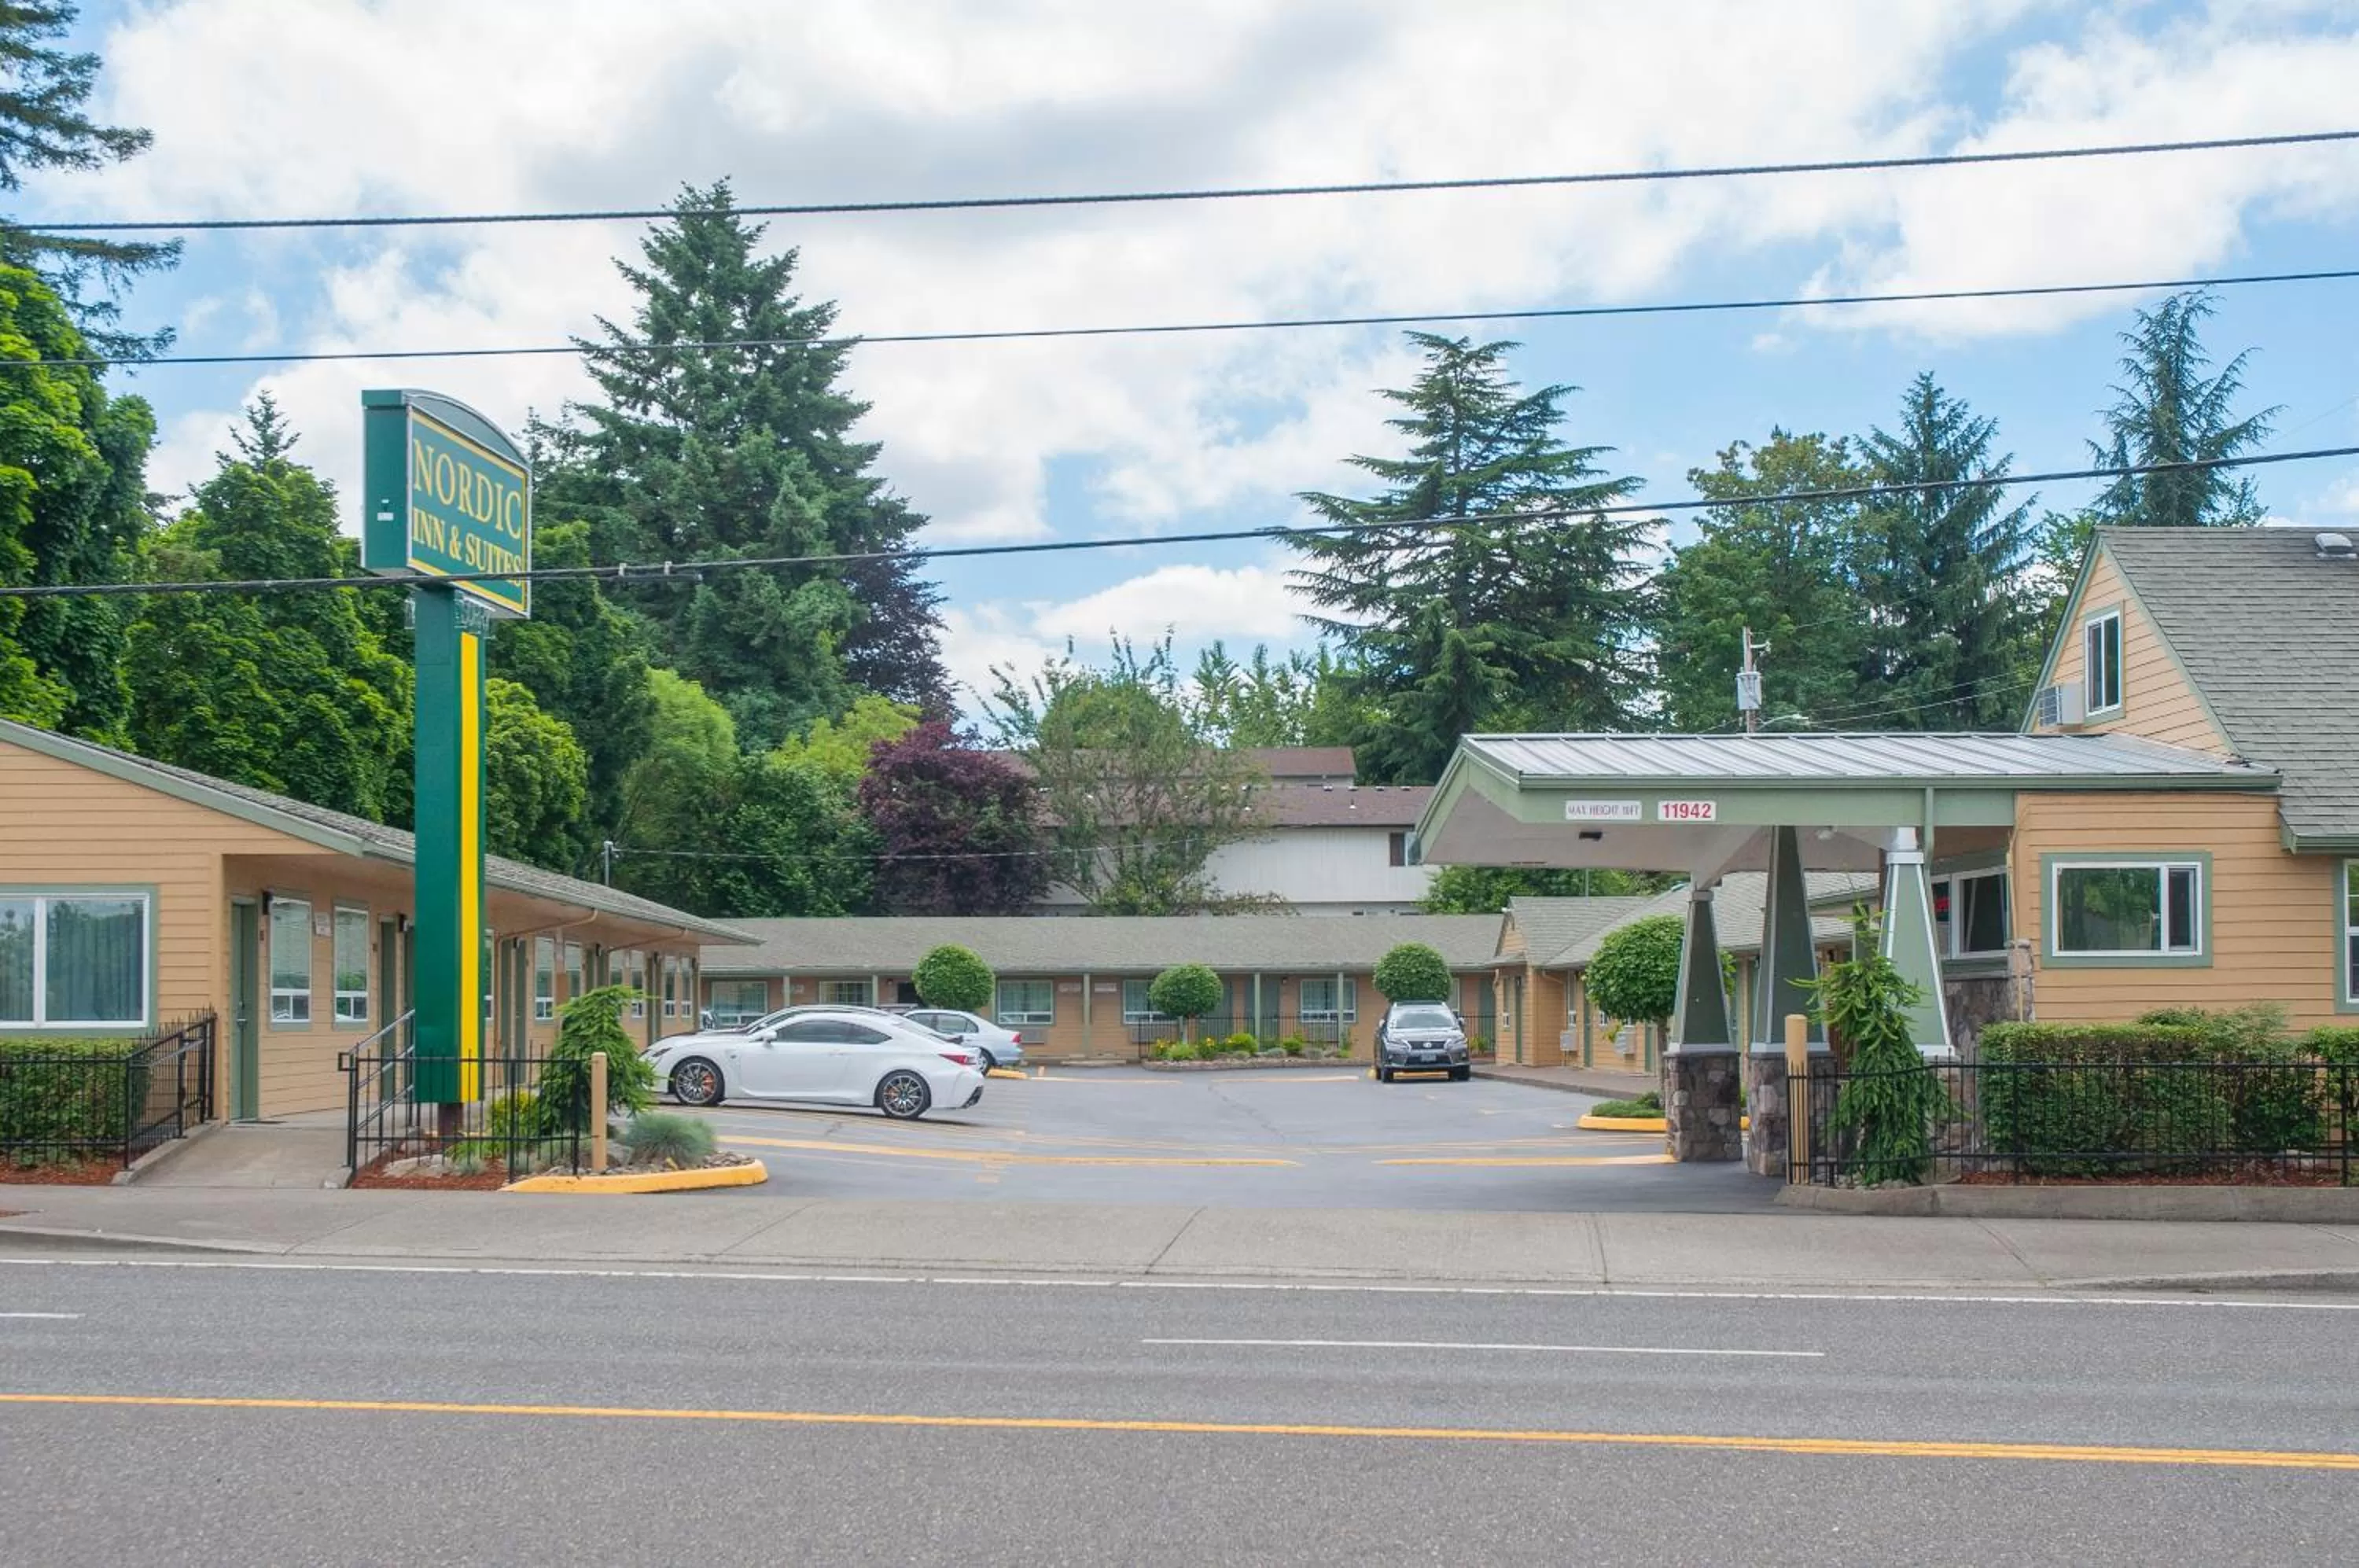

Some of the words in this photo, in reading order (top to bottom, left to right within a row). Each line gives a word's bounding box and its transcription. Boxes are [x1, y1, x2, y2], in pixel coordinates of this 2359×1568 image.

[414, 439, 521, 539] NORDIC
[413, 507, 446, 554] INN
[449, 525, 461, 561] &
[465, 532, 522, 587] SUITES
[1662, 804, 1712, 819] 11942
